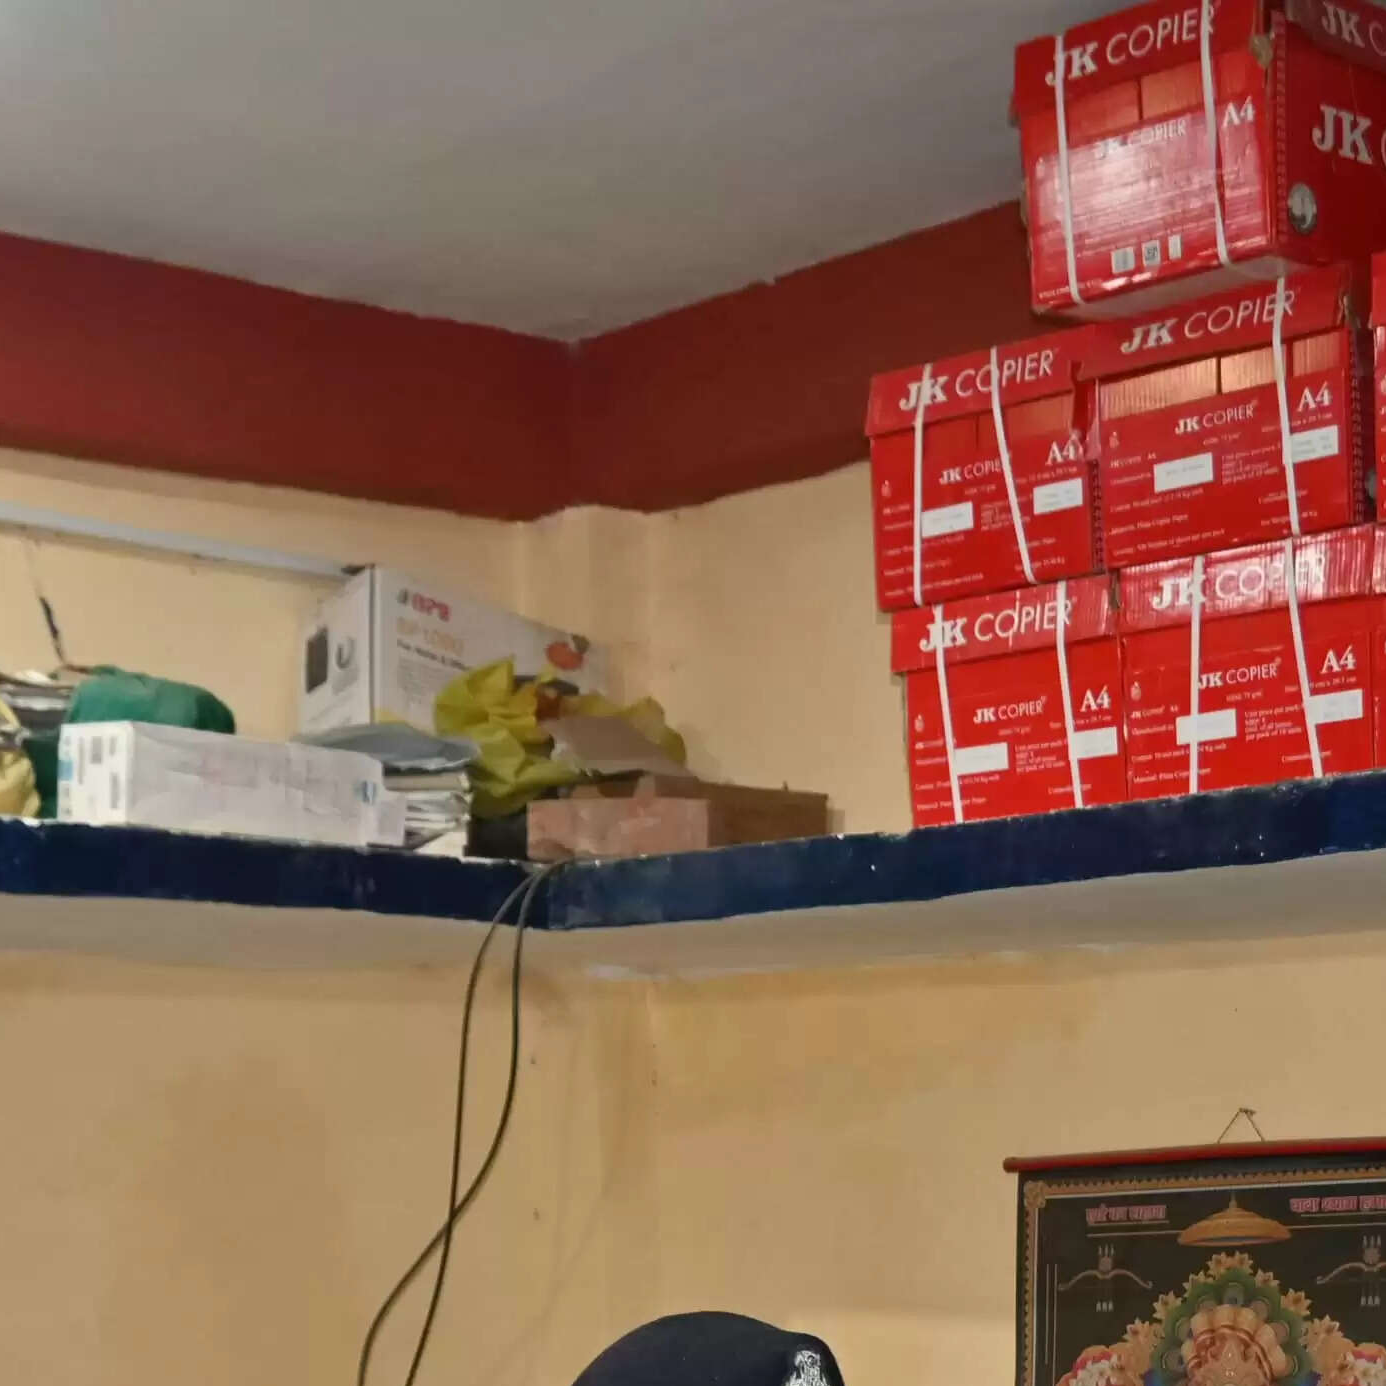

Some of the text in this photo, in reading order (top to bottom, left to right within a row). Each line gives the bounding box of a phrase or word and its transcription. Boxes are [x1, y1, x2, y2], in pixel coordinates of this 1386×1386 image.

[1321, 2, 1365, 49] JK
[1045, 41, 1099, 87] JK
[1222, 95, 1256, 129] A4
[1312, 103, 1373, 165] JK
[1120, 289, 1296, 354] JK COPIER
[899, 348, 1055, 411] JK COPIER
[1297, 381, 1333, 412] A4
[1174, 415, 1201, 436] JK
[1045, 436, 1079, 466] A4
[939, 465, 962, 486] JK
[1151, 574, 1207, 611] JK
[919, 597, 1073, 653] JK COPIER
[1199, 661, 1278, 689] JK COPIER
[1319, 644, 1357, 674] A4
[973, 698, 1044, 724] JK COPIER
[1080, 685, 1111, 713] A4
